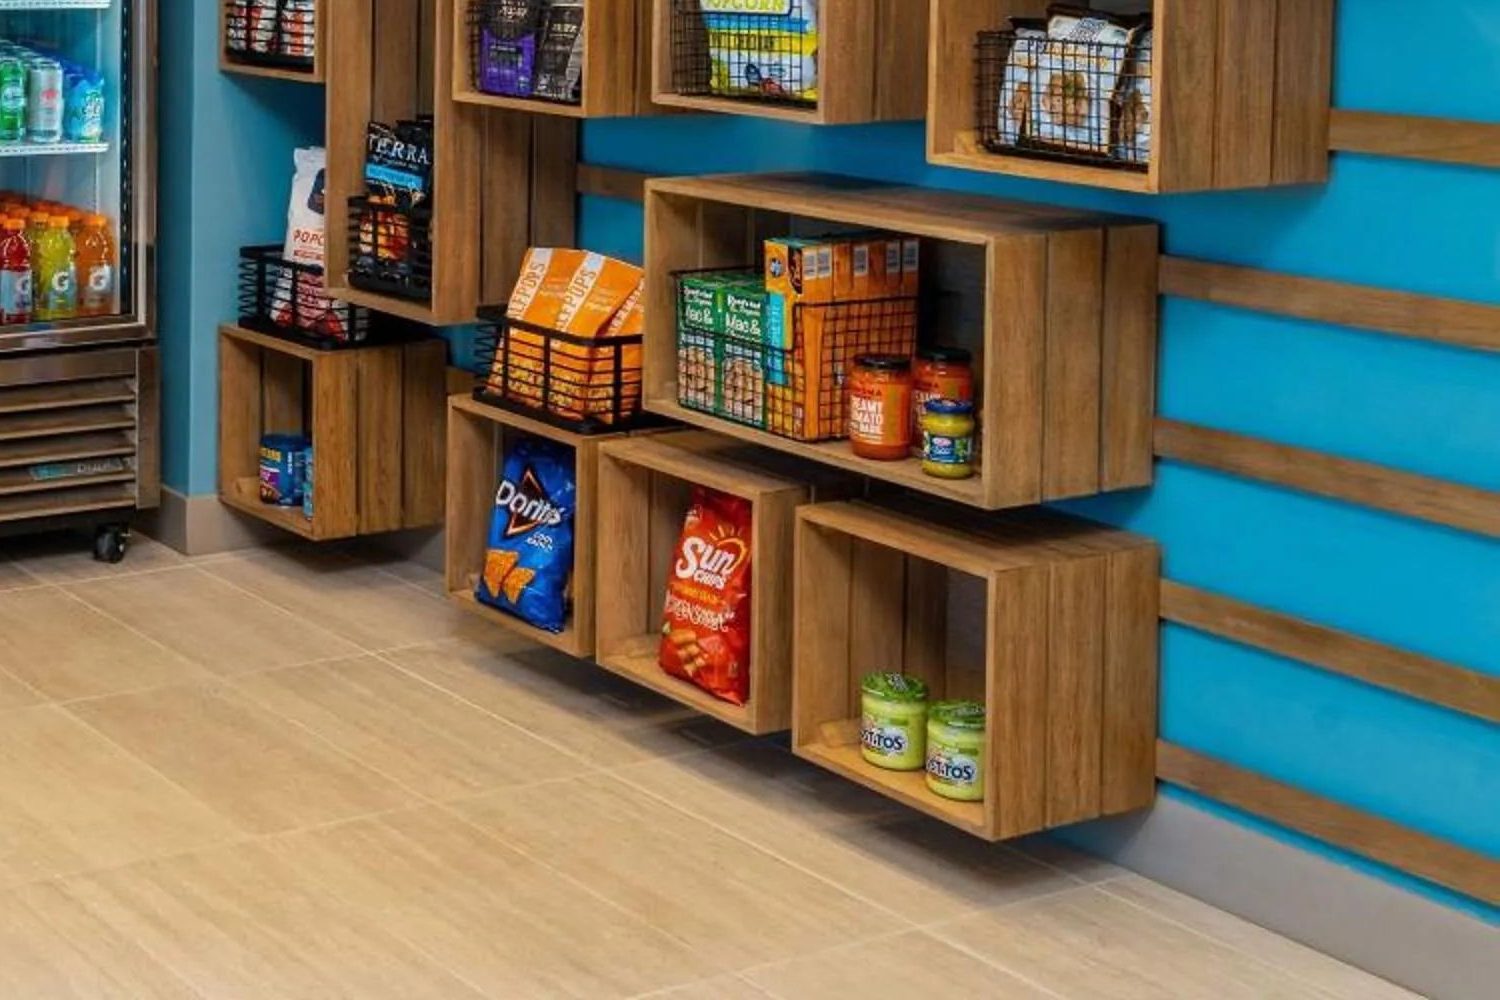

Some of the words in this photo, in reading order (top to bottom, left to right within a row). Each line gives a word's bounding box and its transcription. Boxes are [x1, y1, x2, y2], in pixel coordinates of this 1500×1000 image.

[368, 132, 431, 166] TERRA
[293, 228, 325, 247] POPC
[495, 479, 562, 525] Doritos
[675, 536, 736, 579] Sun
